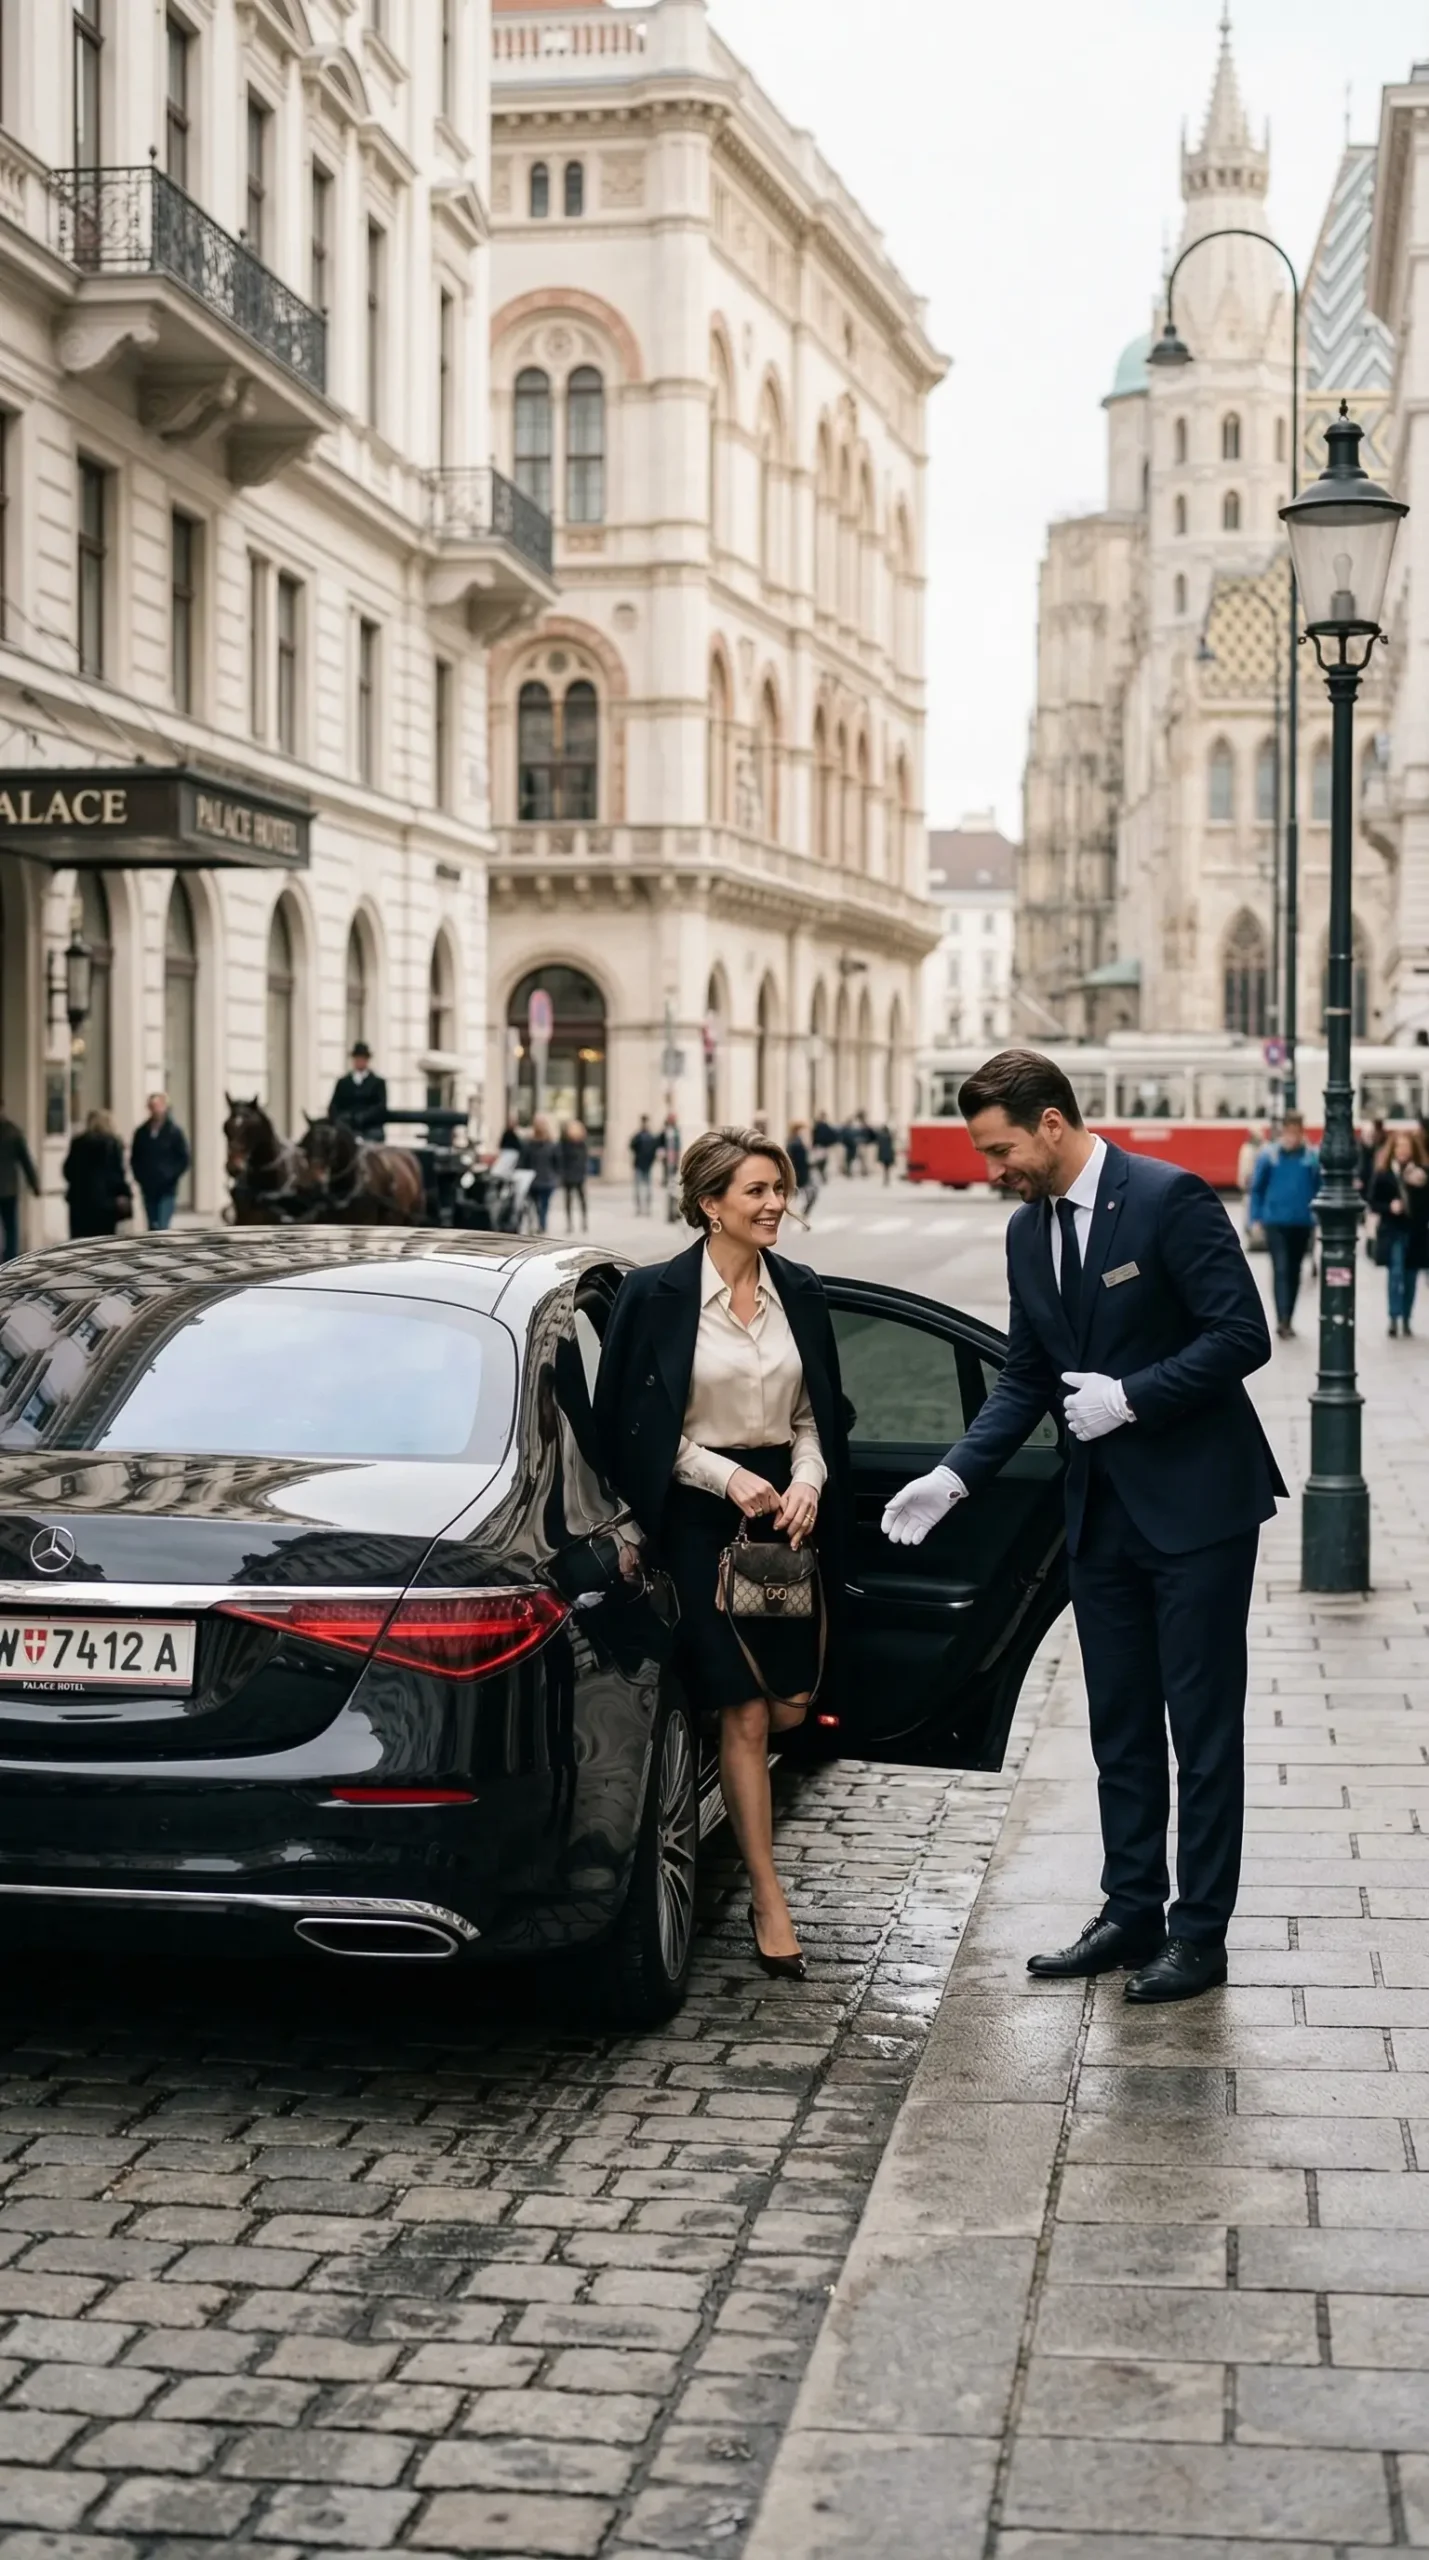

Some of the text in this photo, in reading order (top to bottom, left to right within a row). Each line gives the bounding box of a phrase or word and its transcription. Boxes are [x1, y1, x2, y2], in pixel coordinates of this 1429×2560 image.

[0, 789, 127, 824] ALACE
[196, 793, 299, 856] PALACE HOTEL
[53, 1629, 143, 1671] 7412
[154, 1632, 177, 1672] A
[23, 1681, 85, 1692] PALACE HOTEL
